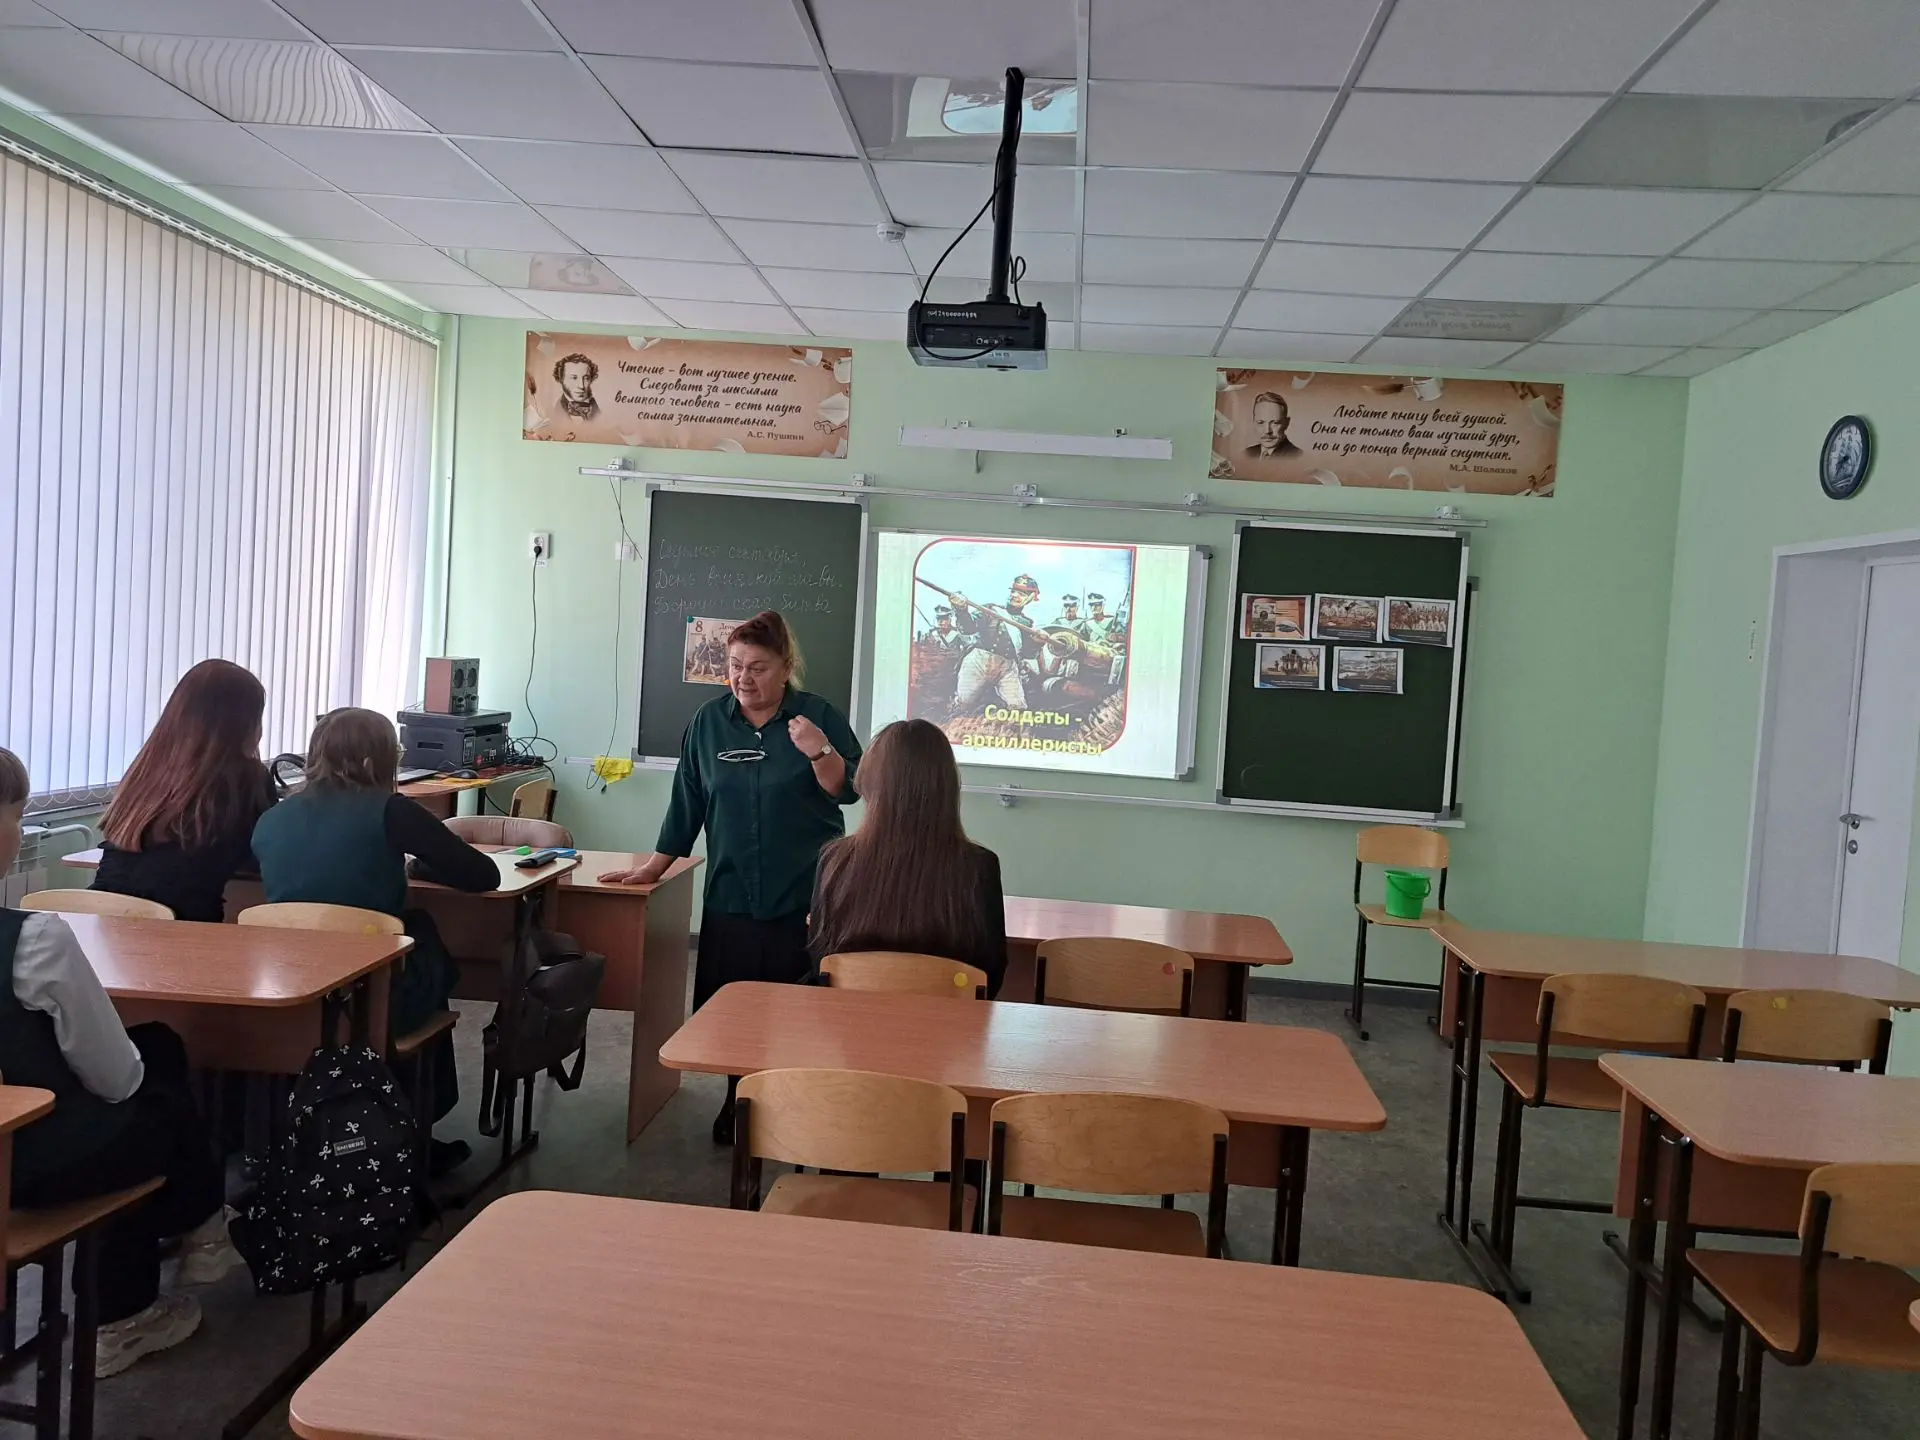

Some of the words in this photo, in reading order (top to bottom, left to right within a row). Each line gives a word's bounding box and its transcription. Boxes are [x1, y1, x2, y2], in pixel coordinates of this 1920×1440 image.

[618, 360, 665, 375] Чтение
[679, 362, 703, 377] вот
[706, 369, 750, 383] лучшее
[750, 371, 797, 385] учение.
[640, 377, 703, 395] Следовать
[704, 384, 719, 398] за
[614, 390, 666, 406] великого
[670, 394, 720, 409] человека
[734, 401, 762, 411] есть
[765, 403, 802, 417] наука
[637, 411, 675, 421] самая
[674, 413, 777, 428] занимательная.
[1333, 404, 1389, 419] Любите
[1391, 410, 1429, 426] книгу
[1431, 408, 1462, 423] всей
[1459, 412, 1507, 428] душой.
[767, 431, 804, 441] Пушкин
[1311, 420, 1338, 434] Она
[1340, 426, 1357, 436] не
[1360, 426, 1405, 438] только
[1407, 424, 1434, 438] ваш
[1436, 429, 1488, 445] лучший
[1487, 432, 1520, 448] друг,
[1312, 442, 1329, 451] но
[1331, 442, 1340, 452] и
[1340, 442, 1358, 457] до
[1359, 443, 1398, 457] конца
[1450, 448, 1511, 463] спутник.
[694, 620, 703, 632] 8
[983, 702, 1070, 726] Солдаты
[961, 732, 1103, 757] артиллеристы
